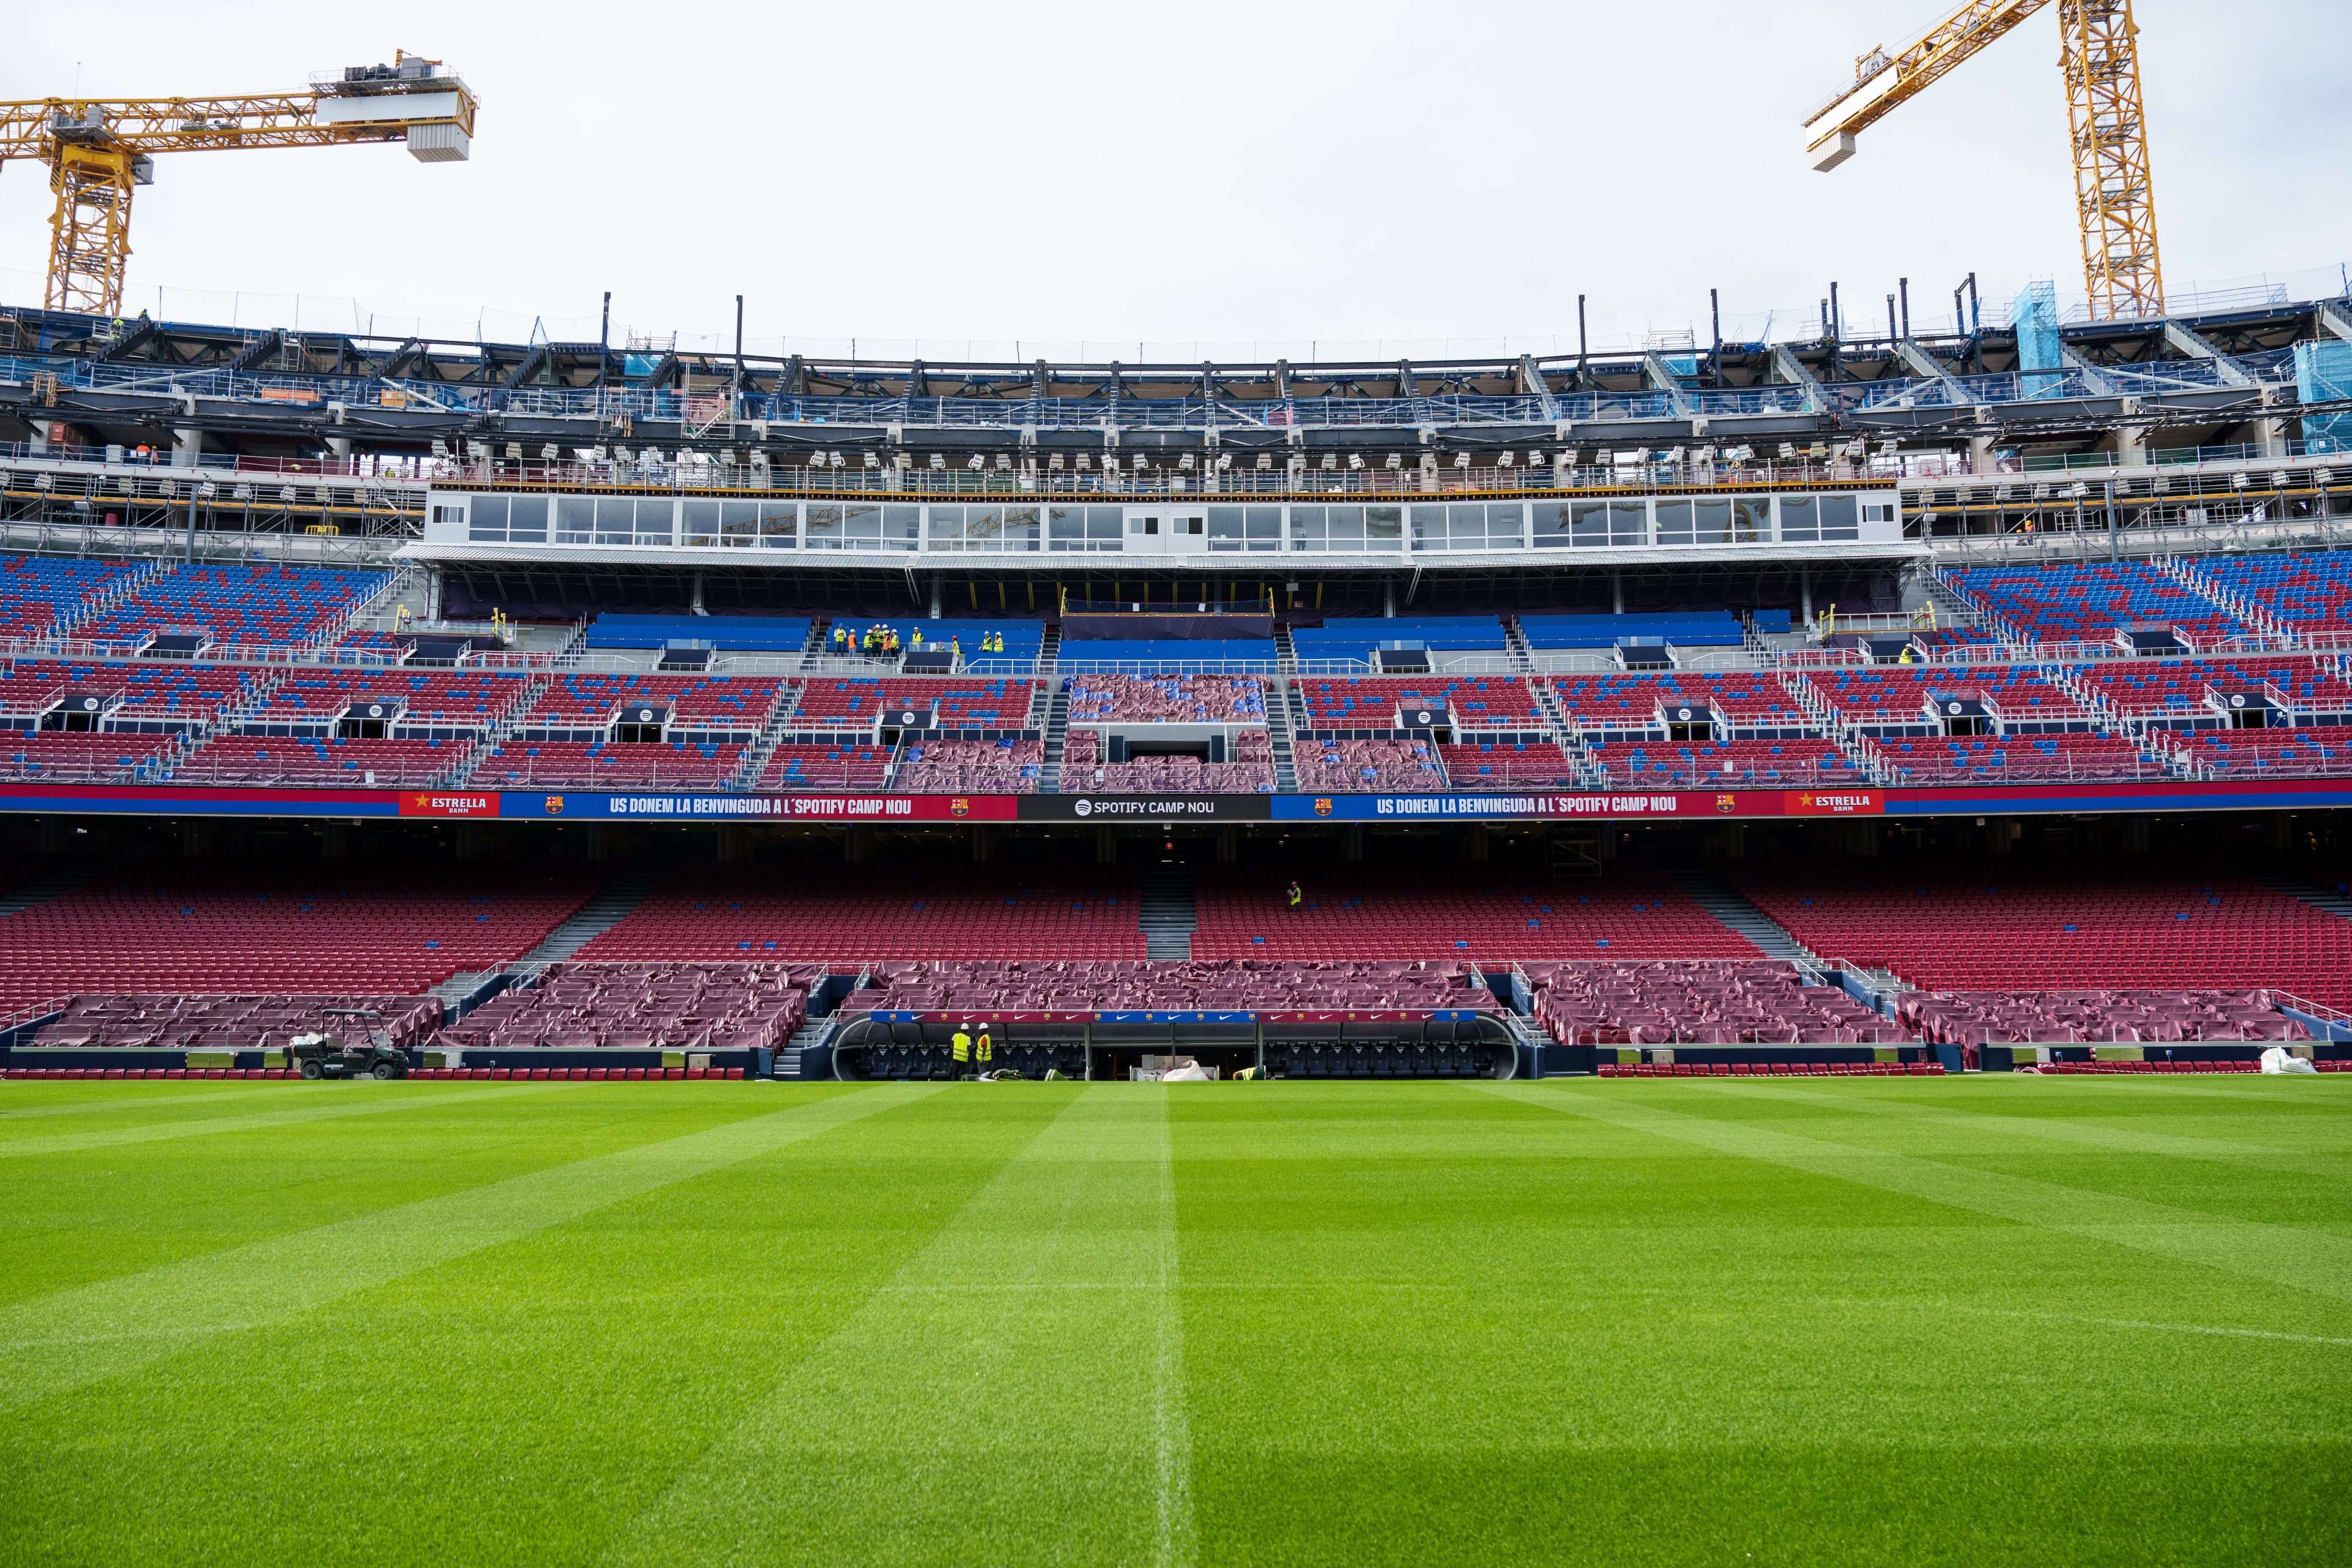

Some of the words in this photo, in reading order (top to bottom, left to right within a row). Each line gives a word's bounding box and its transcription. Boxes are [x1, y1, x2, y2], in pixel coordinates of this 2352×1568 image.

[431, 797, 486, 808] ESTRELLA
[611, 798, 627, 813] US
[630, 798, 673, 813] DONEM
[677, 799, 690, 813] LA
[694, 799, 771, 813] BENVINGUDA
[774, 799, 781, 813] A
[848, 799, 883, 814] CAMP
[886, 800, 911, 814] NOU
[1378, 799, 1393, 813] US
[1396, 799, 1439, 813] DONEM
[1442, 799, 1456, 813] LA
[1459, 798, 1535, 813] BENVINGUDA
[1538, 797, 1546, 812] A
[1612, 797, 1648, 812] CAMP
[1651, 796, 1676, 811] NOU
[1815, 796, 1870, 806] ESTRELLA
[1094, 802, 1146, 813] SPOTIFY
[1149, 802, 1185, 813] CAMP
[1188, 802, 1214, 813] NOU
